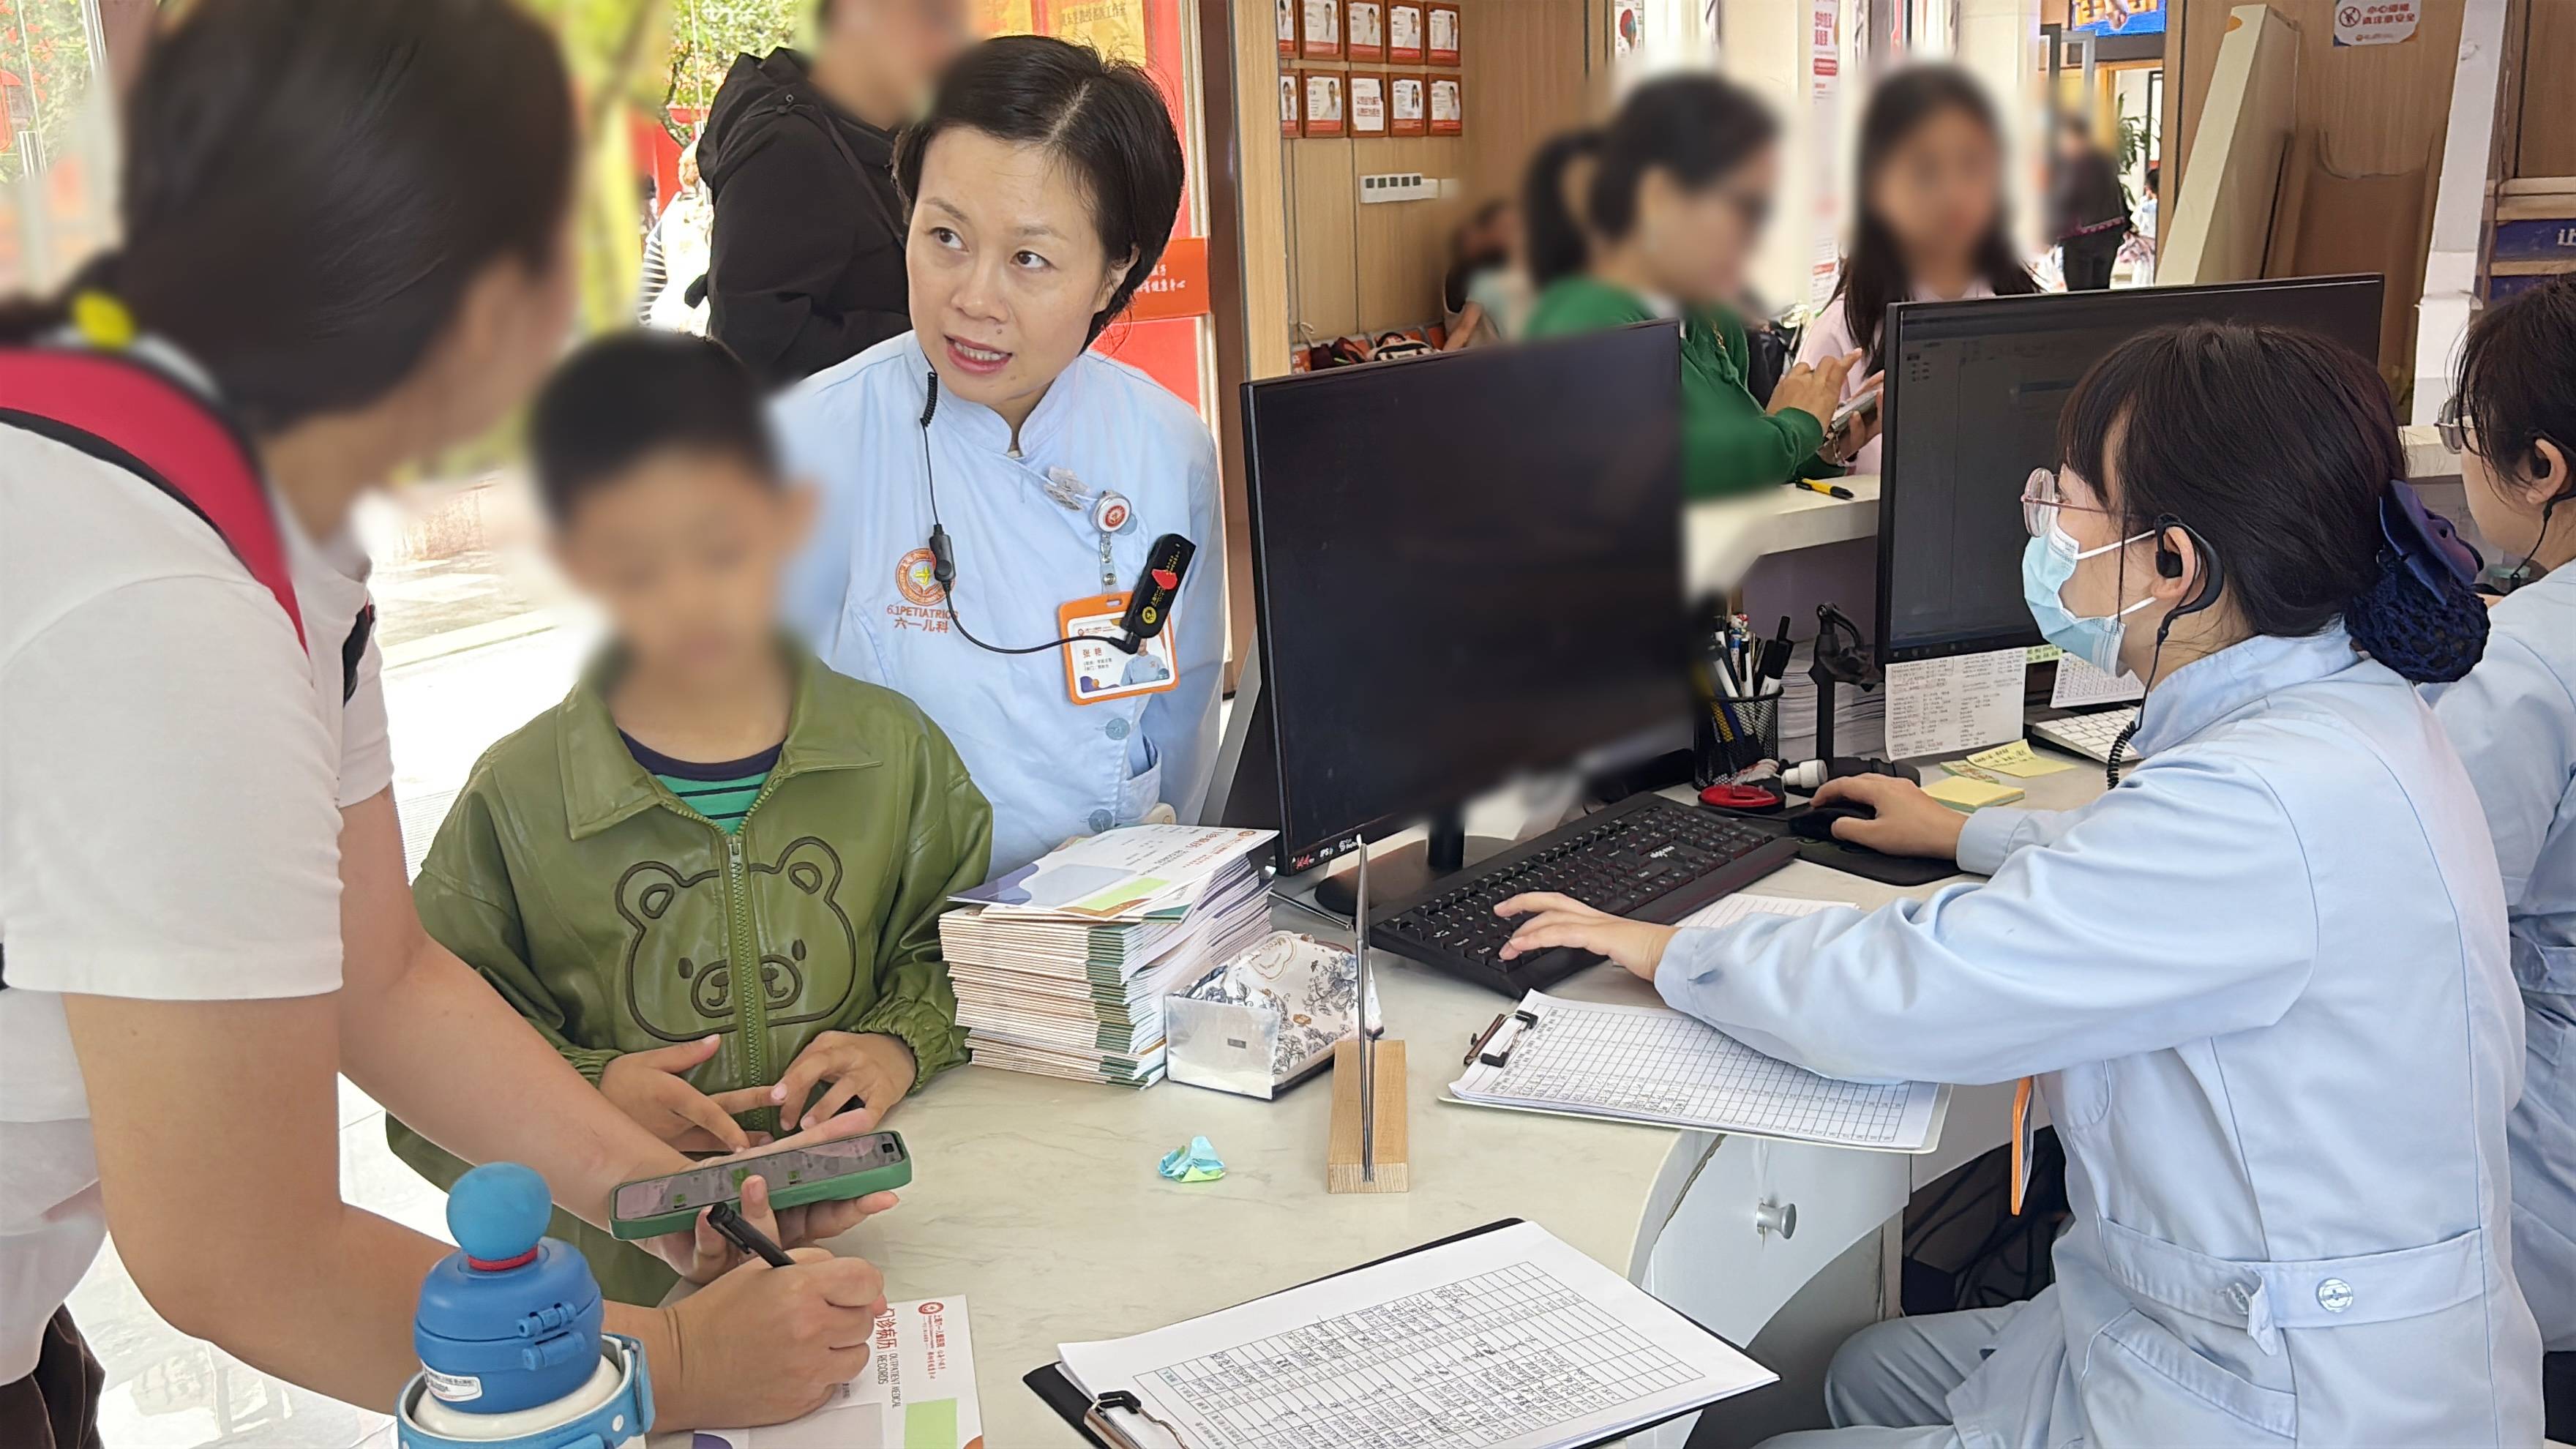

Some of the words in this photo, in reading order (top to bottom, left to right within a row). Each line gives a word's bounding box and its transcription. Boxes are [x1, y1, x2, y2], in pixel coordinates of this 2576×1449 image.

[894, 617, 948, 633] 六一儿科
[875, 1308, 897, 1349] 门诊病历
[877, 1355, 888, 1385] RECORDS
[888, 1353, 900, 1385] OUTPATIENT
[891, 1386, 902, 1409] MEDICAL
